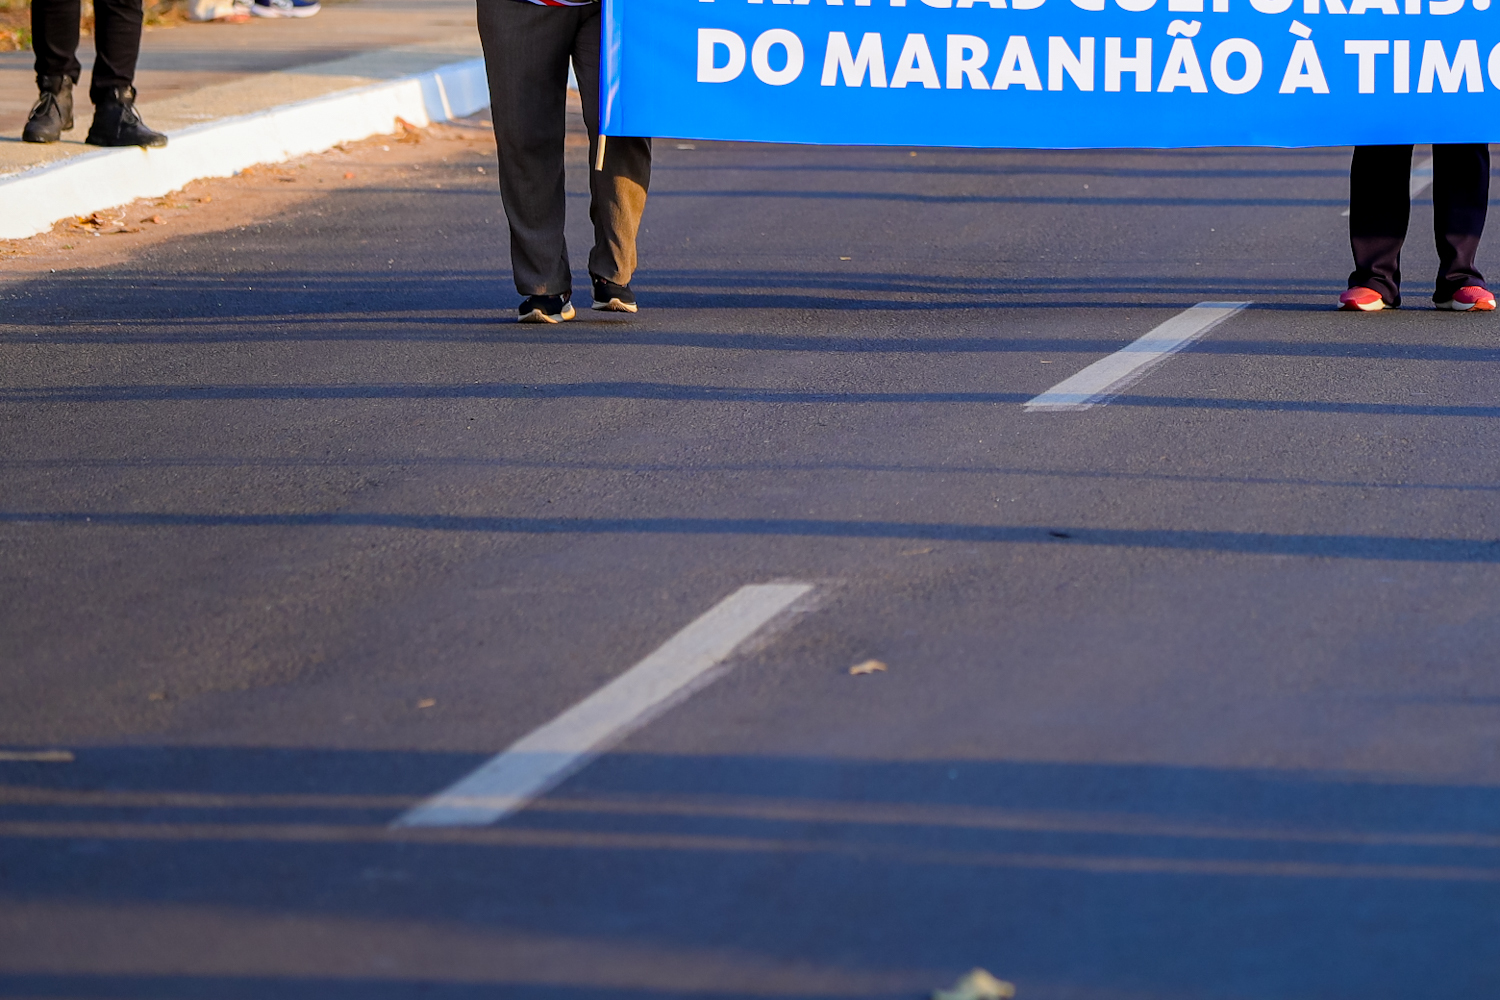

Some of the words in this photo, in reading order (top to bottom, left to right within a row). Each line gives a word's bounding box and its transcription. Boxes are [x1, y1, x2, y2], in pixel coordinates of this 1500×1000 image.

[697, 28, 804, 85] DO
[821, 20, 1262, 94] MARANHÃO
[1279, 20, 1329, 93] À
